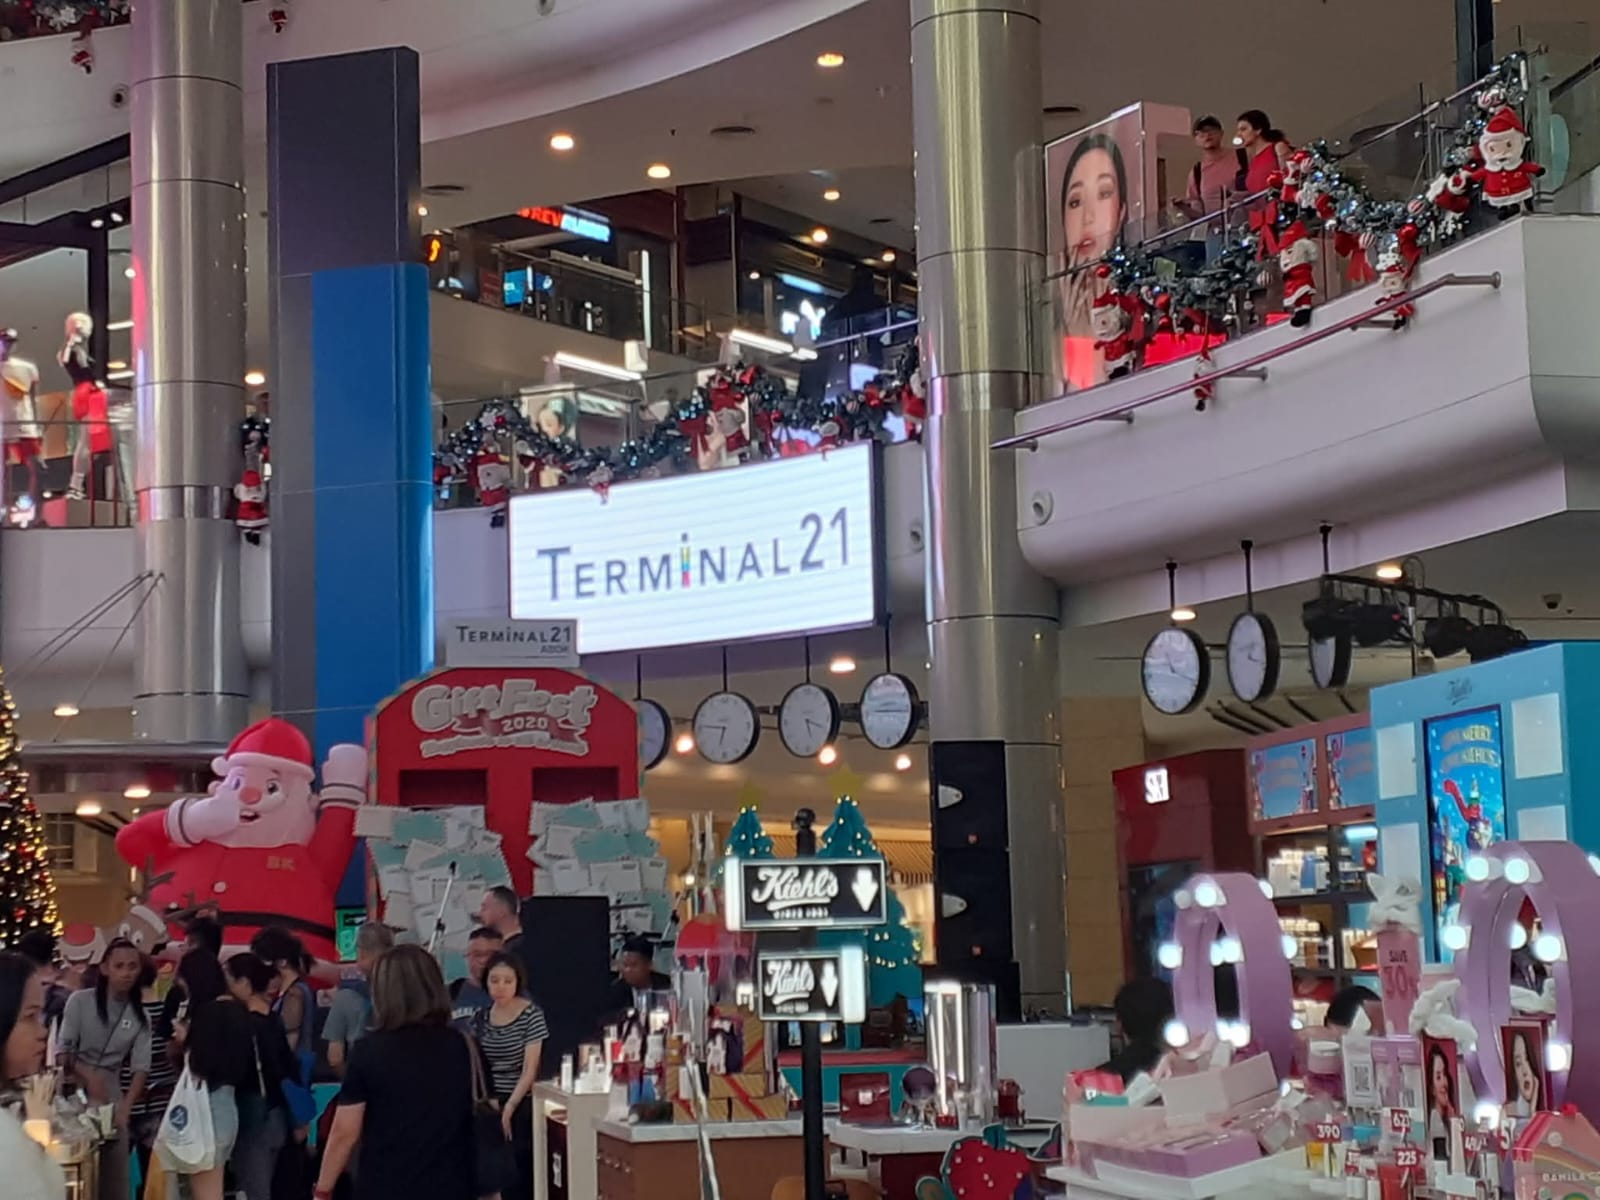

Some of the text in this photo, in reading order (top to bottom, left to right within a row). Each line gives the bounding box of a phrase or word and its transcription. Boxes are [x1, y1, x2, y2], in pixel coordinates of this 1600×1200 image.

[502, 716, 548, 731] 2020
[752, 866, 839, 903] Kiehl's
[1316, 1123, 1341, 1139] 390
[1396, 1150, 1418, 1166] 225
